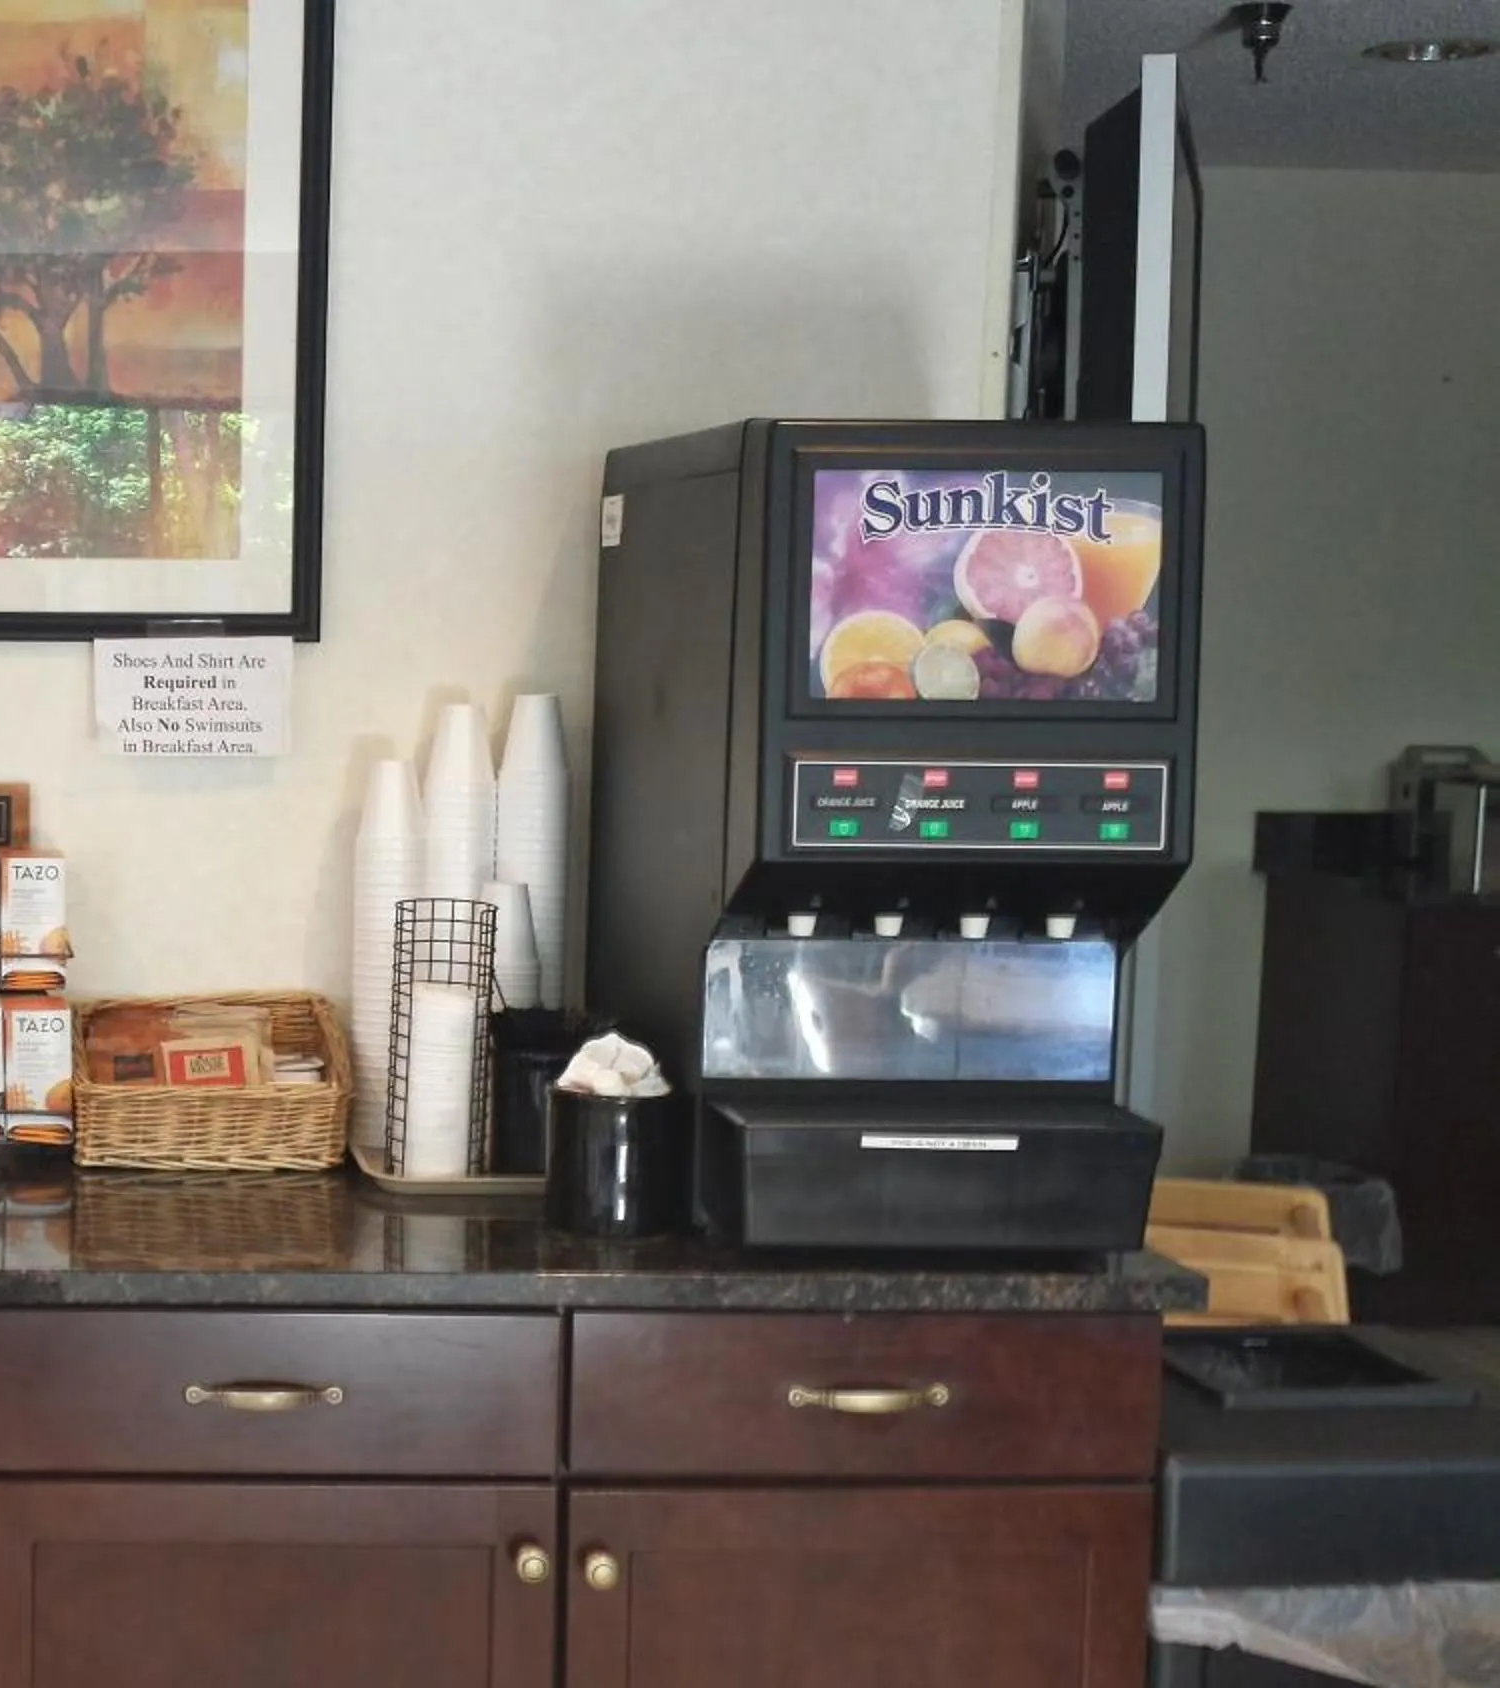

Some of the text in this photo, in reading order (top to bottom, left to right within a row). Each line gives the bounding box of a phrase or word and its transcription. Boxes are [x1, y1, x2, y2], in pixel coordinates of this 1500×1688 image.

[861, 470, 1113, 544] Sunkist
[112, 653, 267, 669] Shoes And Shirt Are
[143, 675, 237, 692] Required in
[132, 696, 247, 711] Breakfast Area.
[117, 718, 263, 733] Also No Swimsuits
[123, 739, 258, 754] in Breakfast Area.
[941, 799, 965, 809] JUICE
[1011, 799, 1038, 810] APPLE
[1102, 801, 1129, 812] APPLE
[12, 865, 59, 881] TAZO
[16, 1017, 65, 1033] TAZO
